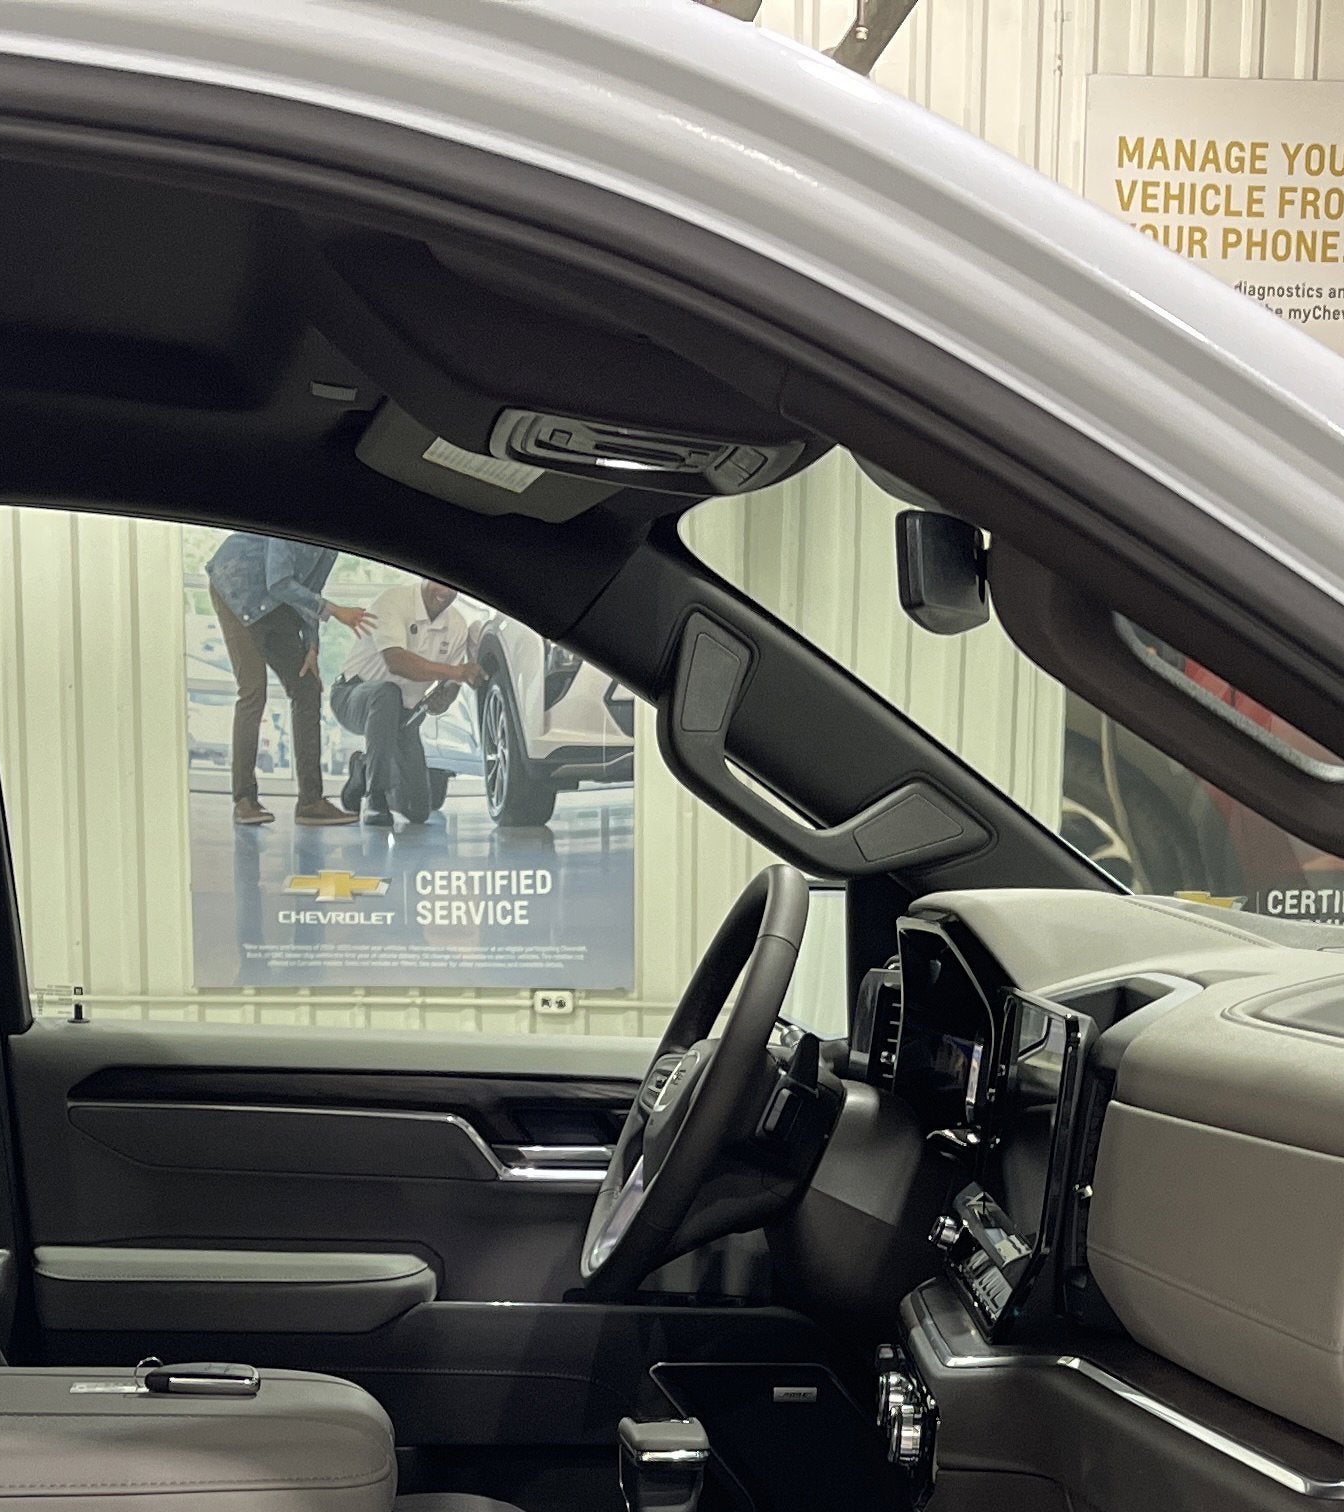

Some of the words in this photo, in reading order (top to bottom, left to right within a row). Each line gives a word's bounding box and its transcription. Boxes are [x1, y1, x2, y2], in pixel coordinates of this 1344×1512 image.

[1117, 136, 1269, 175] MANAGE
[1115, 179, 1266, 218] VEHICLE
[1130, 223, 1208, 259] UR
[415, 869, 552, 896] CERTIFIED
[278, 910, 395, 926] CHEVROLET
[415, 901, 529, 926] SERVICE
